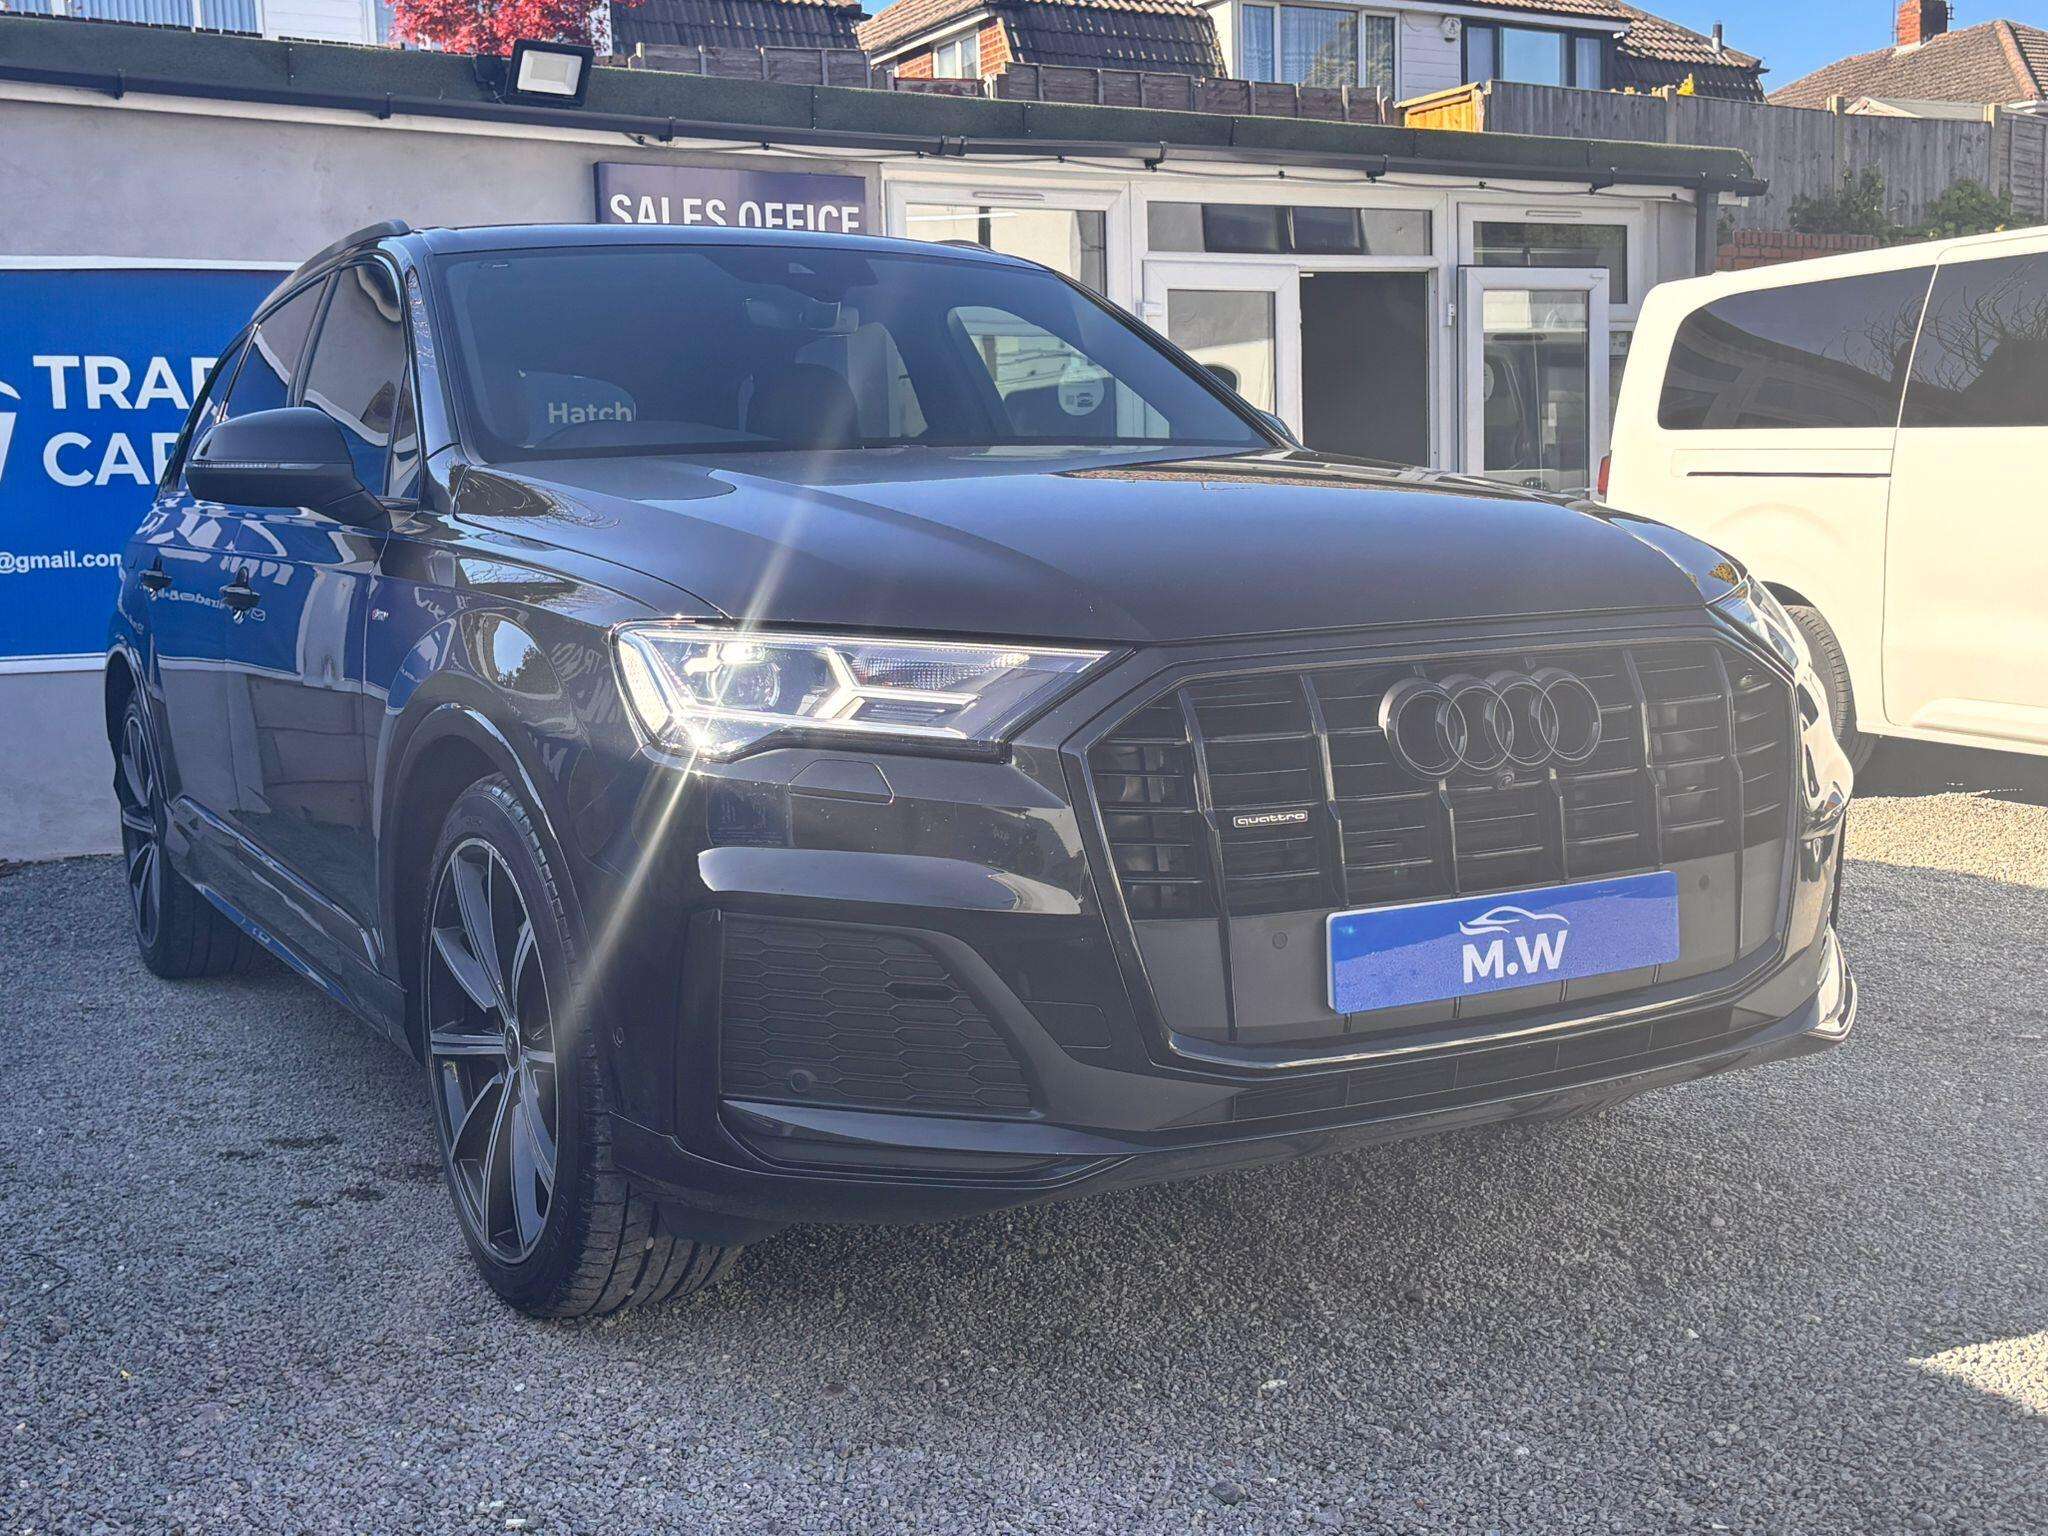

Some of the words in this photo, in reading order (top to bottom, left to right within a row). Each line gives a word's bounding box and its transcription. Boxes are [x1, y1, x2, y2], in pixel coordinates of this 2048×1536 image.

[610, 193, 727, 226] SALES
[738, 200, 859, 233] OFFICE
[548, 401, 632, 423] Hatch
[1237, 813, 1306, 827] quattro
[1462, 930, 1568, 983] M.W
